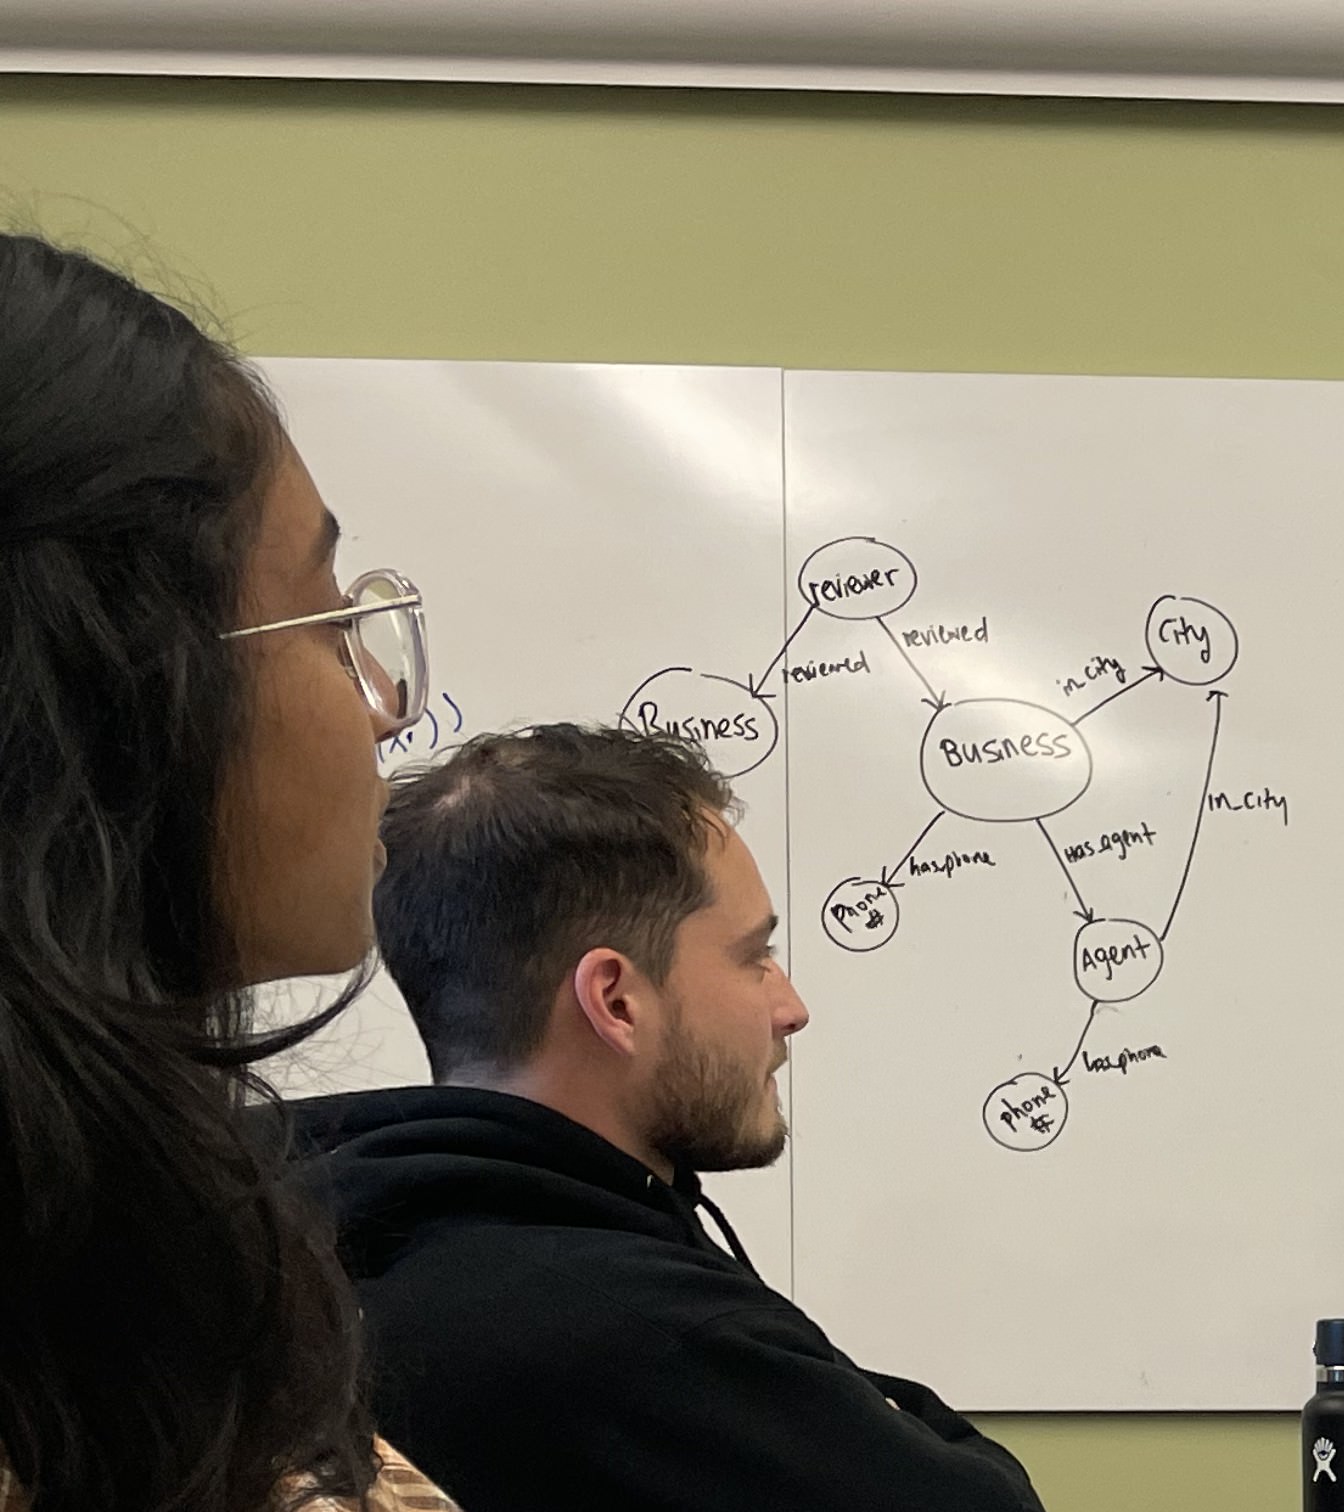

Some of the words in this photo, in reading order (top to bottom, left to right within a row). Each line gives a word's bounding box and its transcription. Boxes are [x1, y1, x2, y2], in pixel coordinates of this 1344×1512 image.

[808, 568, 900, 608] reviewer
[902, 616, 988, 647] reviewed
[1158, 616, 1211, 664] City
[939, 732, 1071, 767] Business
[1082, 934, 1151, 981] Agent
